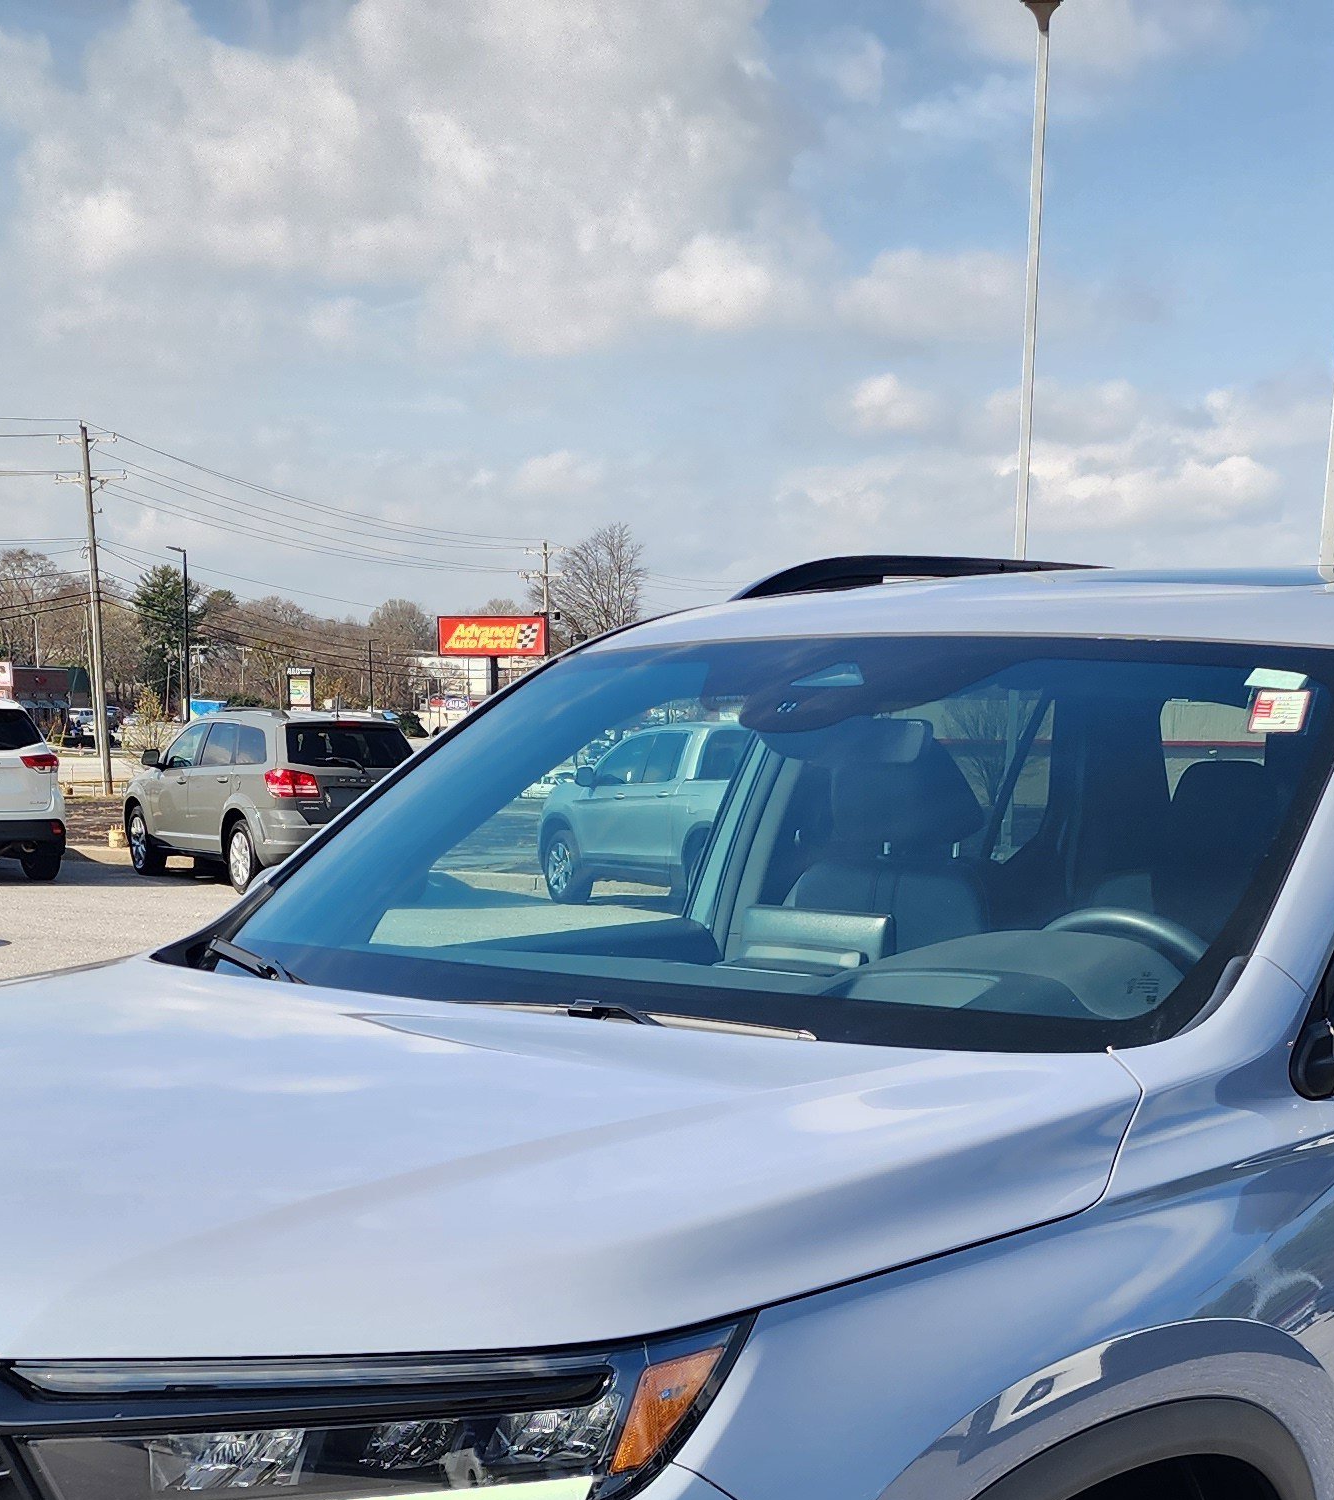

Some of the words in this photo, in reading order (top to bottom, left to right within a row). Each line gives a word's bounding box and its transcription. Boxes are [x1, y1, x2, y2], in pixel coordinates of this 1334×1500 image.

[455, 624, 516, 638] Advance
[445, 638, 478, 649] Auto
[478, 637, 513, 649] Parts
